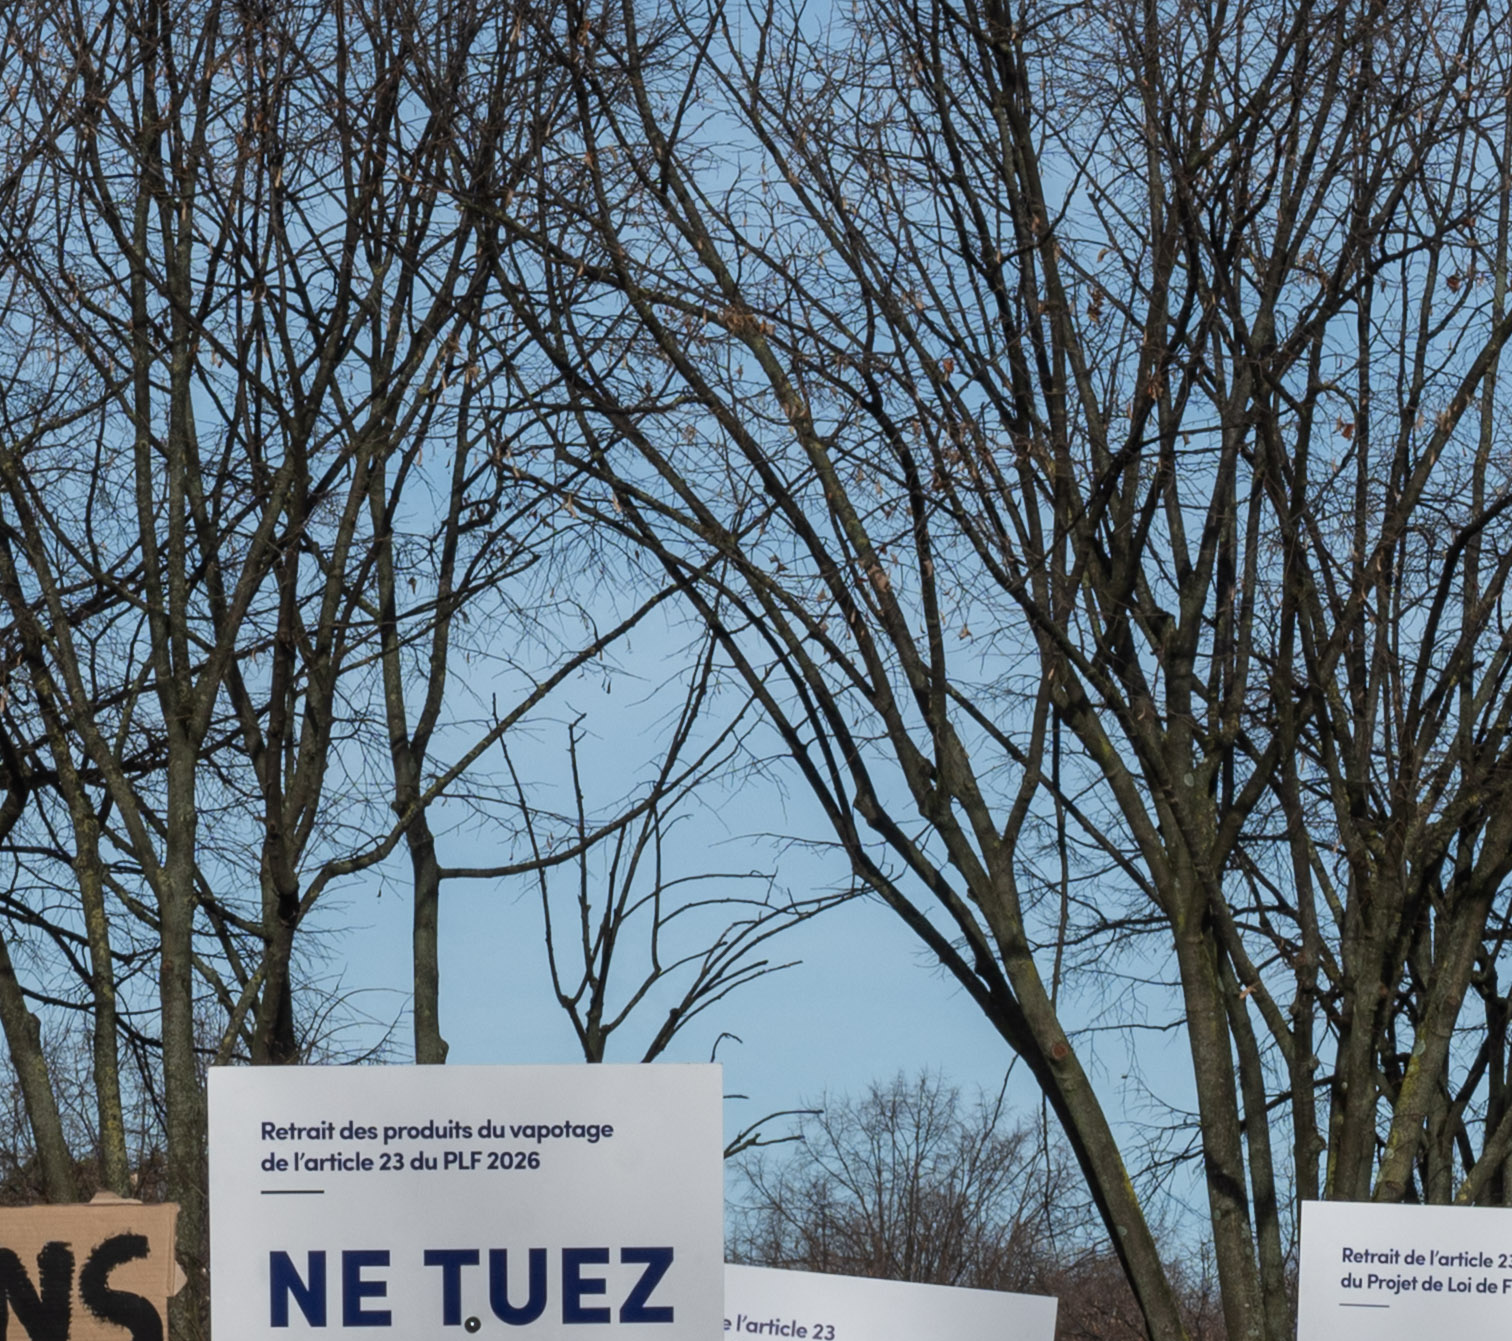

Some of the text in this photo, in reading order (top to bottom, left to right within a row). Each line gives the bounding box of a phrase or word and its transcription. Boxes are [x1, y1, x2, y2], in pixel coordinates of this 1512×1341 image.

[261, 1118, 614, 1146] Retrait des produits du vapotage
[260, 1150, 541, 1172] de l'article 23 du PLF 2026
[1342, 1247, 1401, 1265] Retrait
[1403, 1249, 1426, 1266] de
[1429, 1249, 1494, 1269] l'article
[269, 1246, 675, 1334] NE TUEZ
[1340, 1272, 1363, 1289] du
[1367, 1273, 1419, 1295] Projet
[1421, 1275, 1444, 1292] de
[1447, 1276, 1472, 1293] Loi
[1475, 1277, 1498, 1294] de
